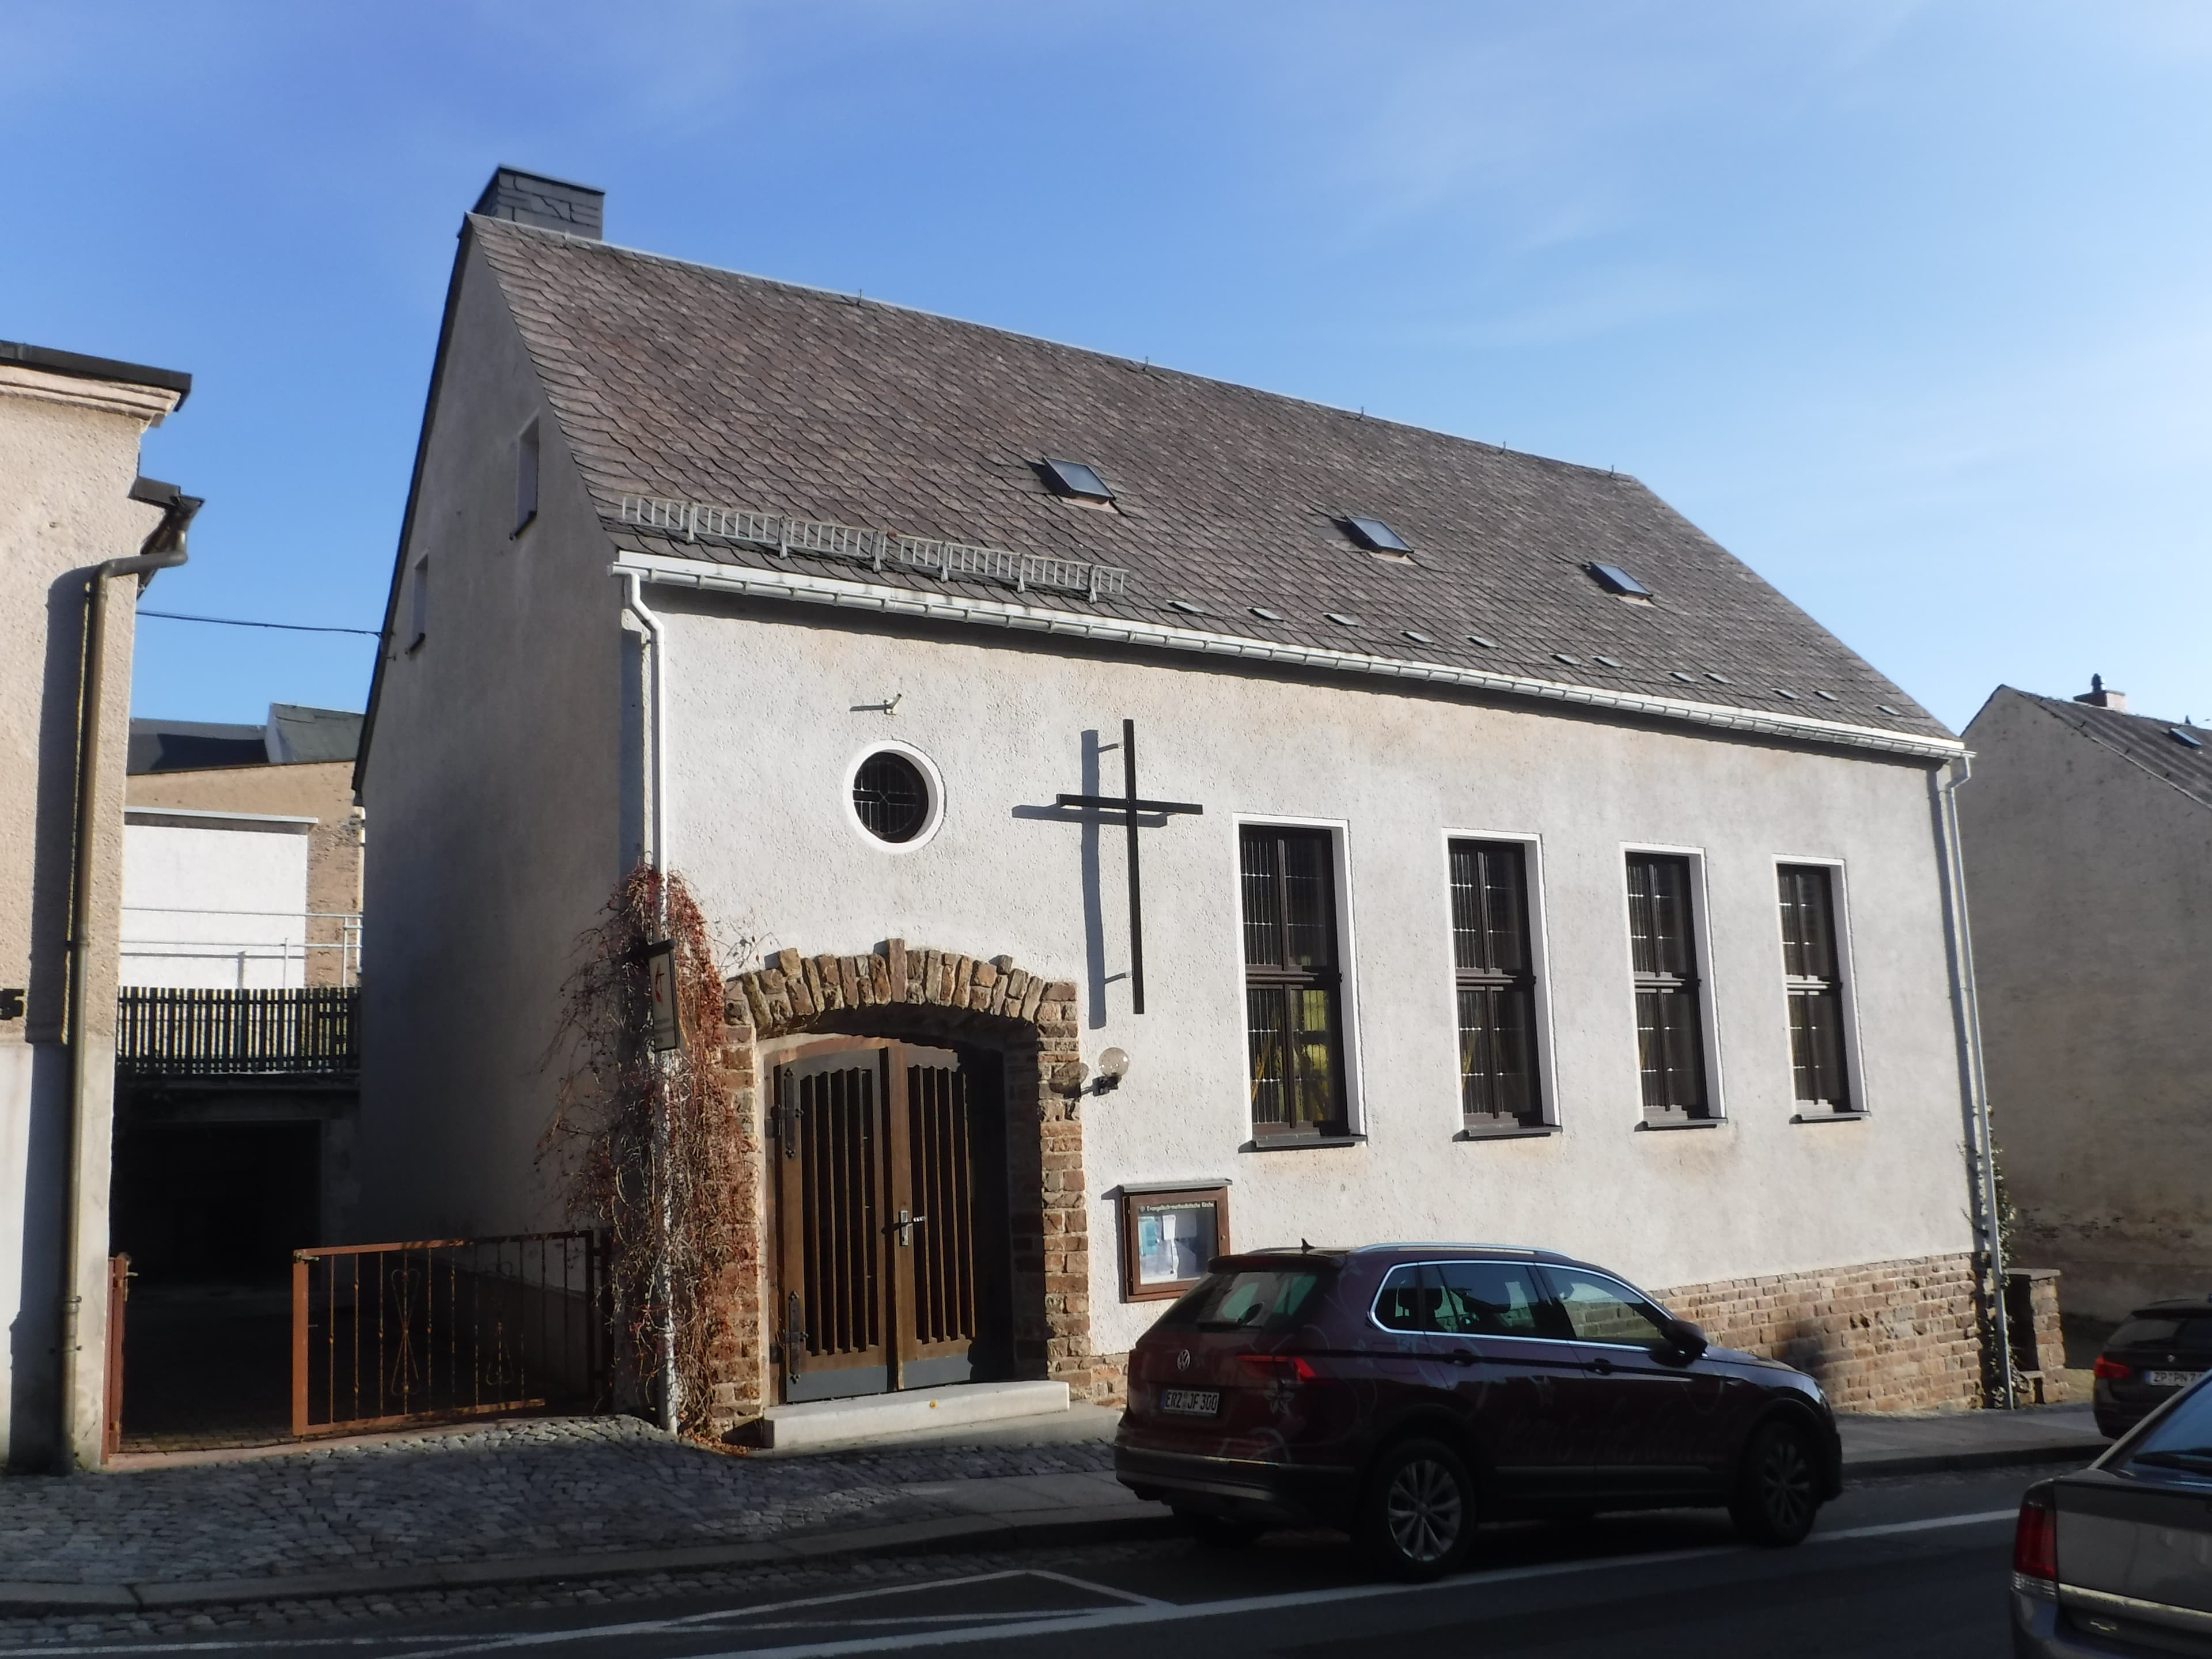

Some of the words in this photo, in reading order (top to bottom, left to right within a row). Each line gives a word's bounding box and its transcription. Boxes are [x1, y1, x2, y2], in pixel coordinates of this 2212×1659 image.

[1165, 1392, 1183, 1408] ERZ
[1187, 1393, 1200, 1409] JF
[1200, 1393, 1218, 1411] 300
